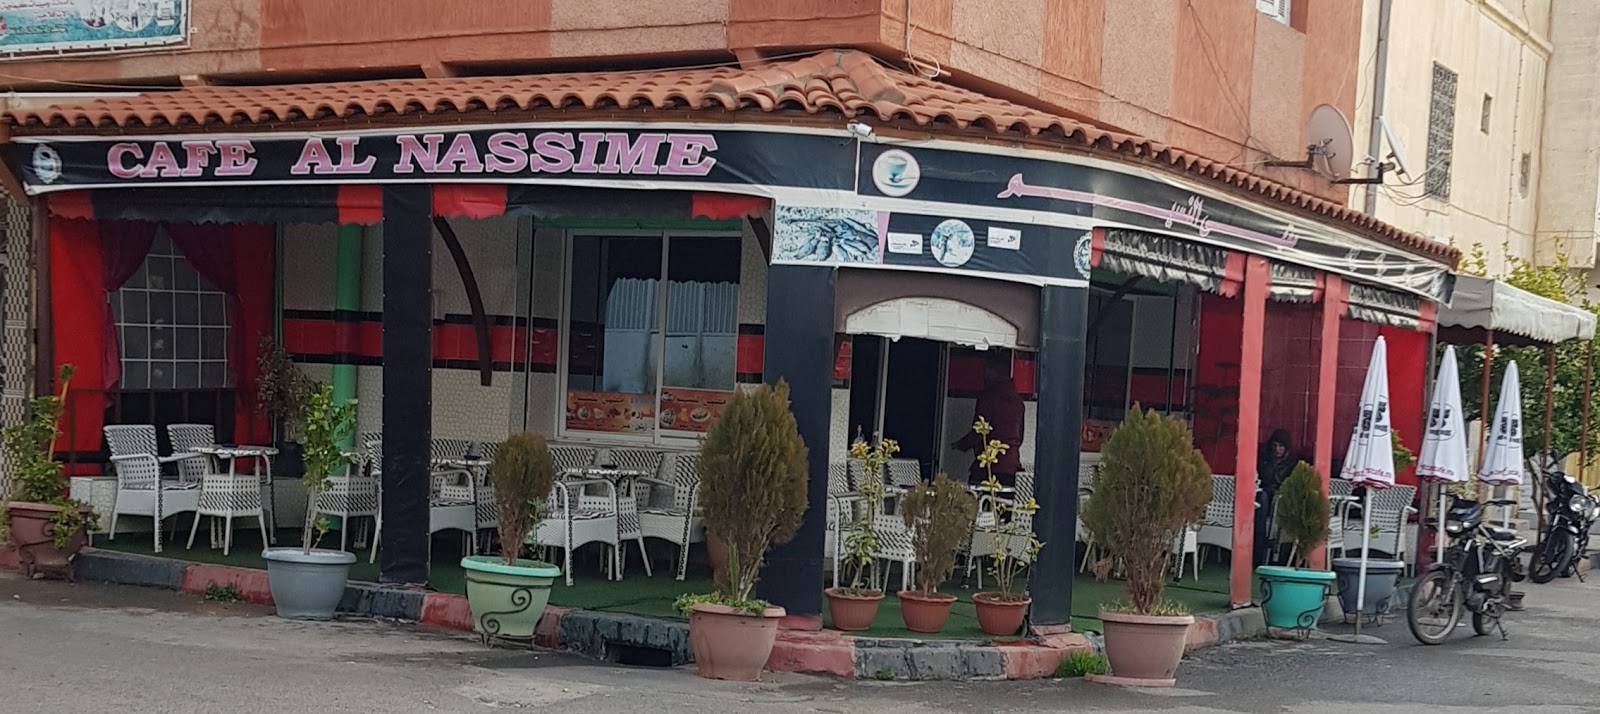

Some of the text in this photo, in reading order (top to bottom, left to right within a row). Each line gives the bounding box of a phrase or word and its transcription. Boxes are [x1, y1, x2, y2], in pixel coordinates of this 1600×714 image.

[107, 131, 719, 178] CAFE AL NASSIME
